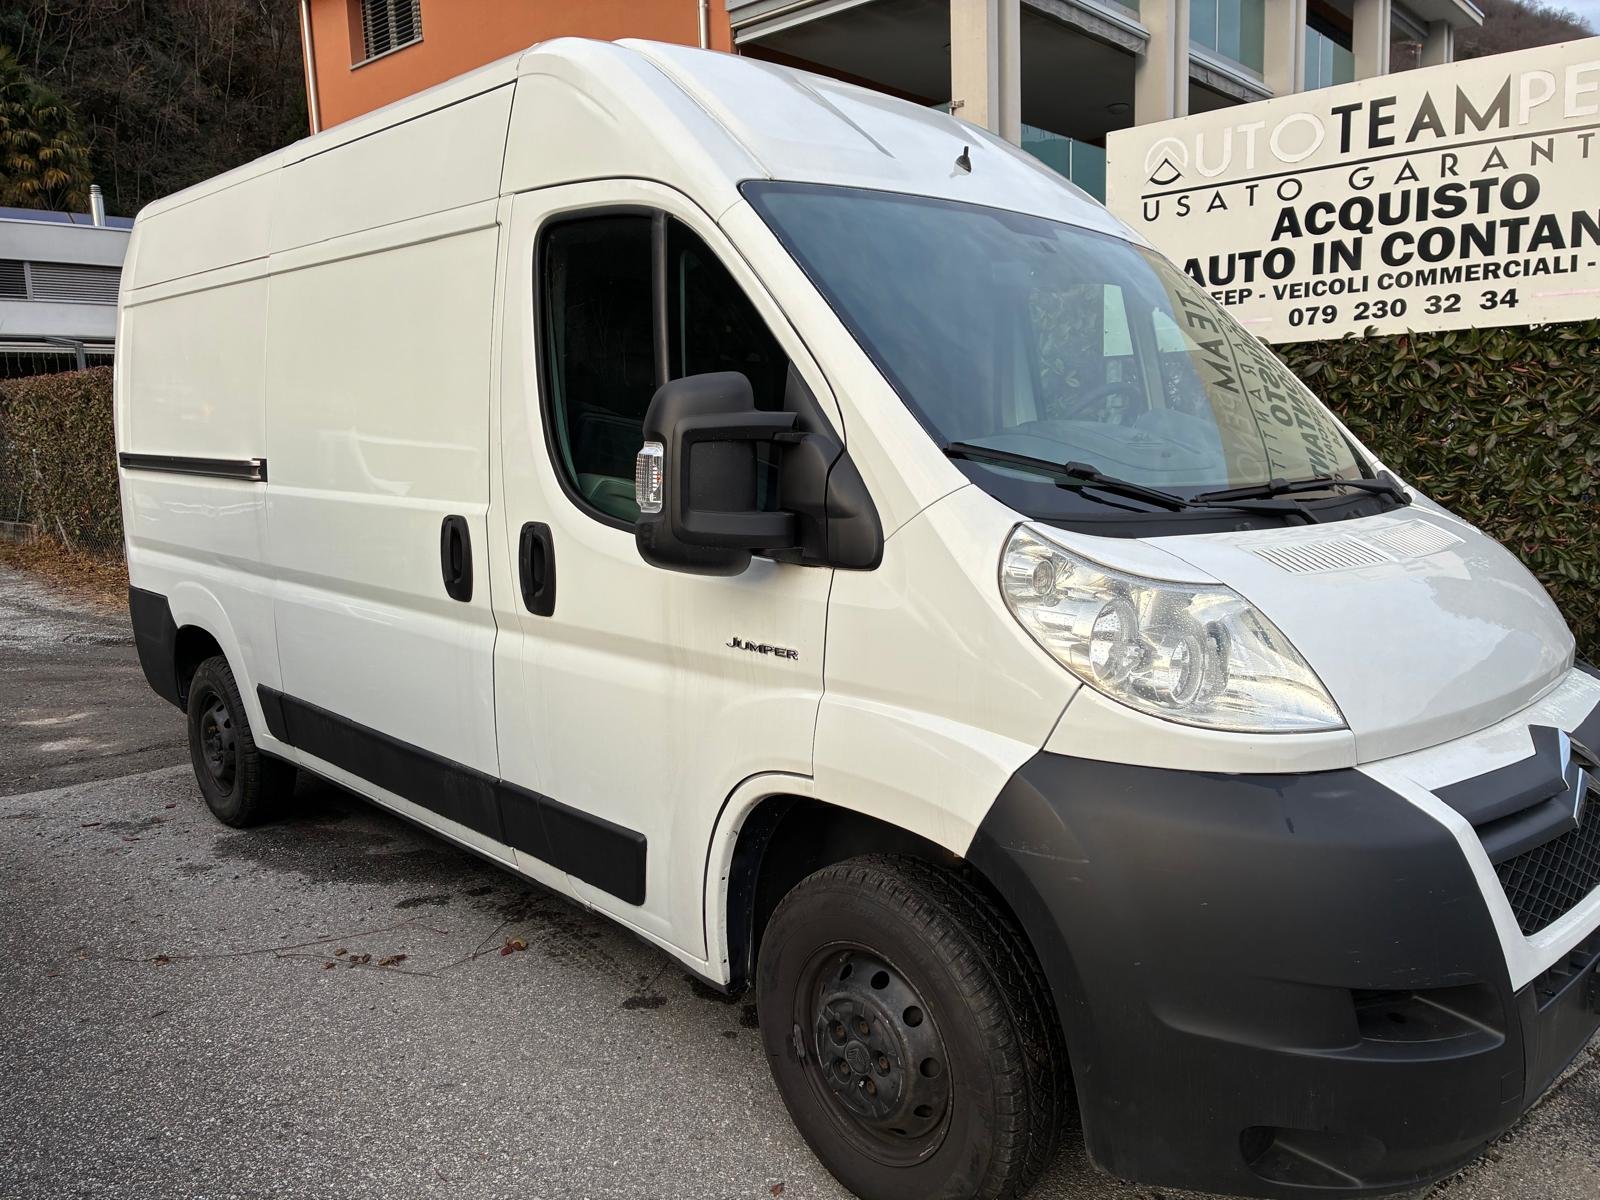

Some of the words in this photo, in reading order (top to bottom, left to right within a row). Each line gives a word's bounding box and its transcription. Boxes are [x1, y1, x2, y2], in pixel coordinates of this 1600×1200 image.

[1143, 178, 1302, 222] USATO
[1348, 132, 1596, 190] GARANT
[1270, 173, 1541, 242] ACQUISTO
[1183, 246, 1296, 288] AUTO
[1312, 237, 1362, 275] IN
[1380, 209, 1600, 267] CONTAN
[1272, 276, 1368, 300] VEICOLI
[1377, 255, 1578, 290] COMMERCIALI
[1288, 304, 1338, 327] 079
[1353, 298, 1407, 321] 230
[1424, 293, 1461, 314] 32
[1479, 288, 1519, 310] 34
[725, 636, 799, 660] JUMPER
